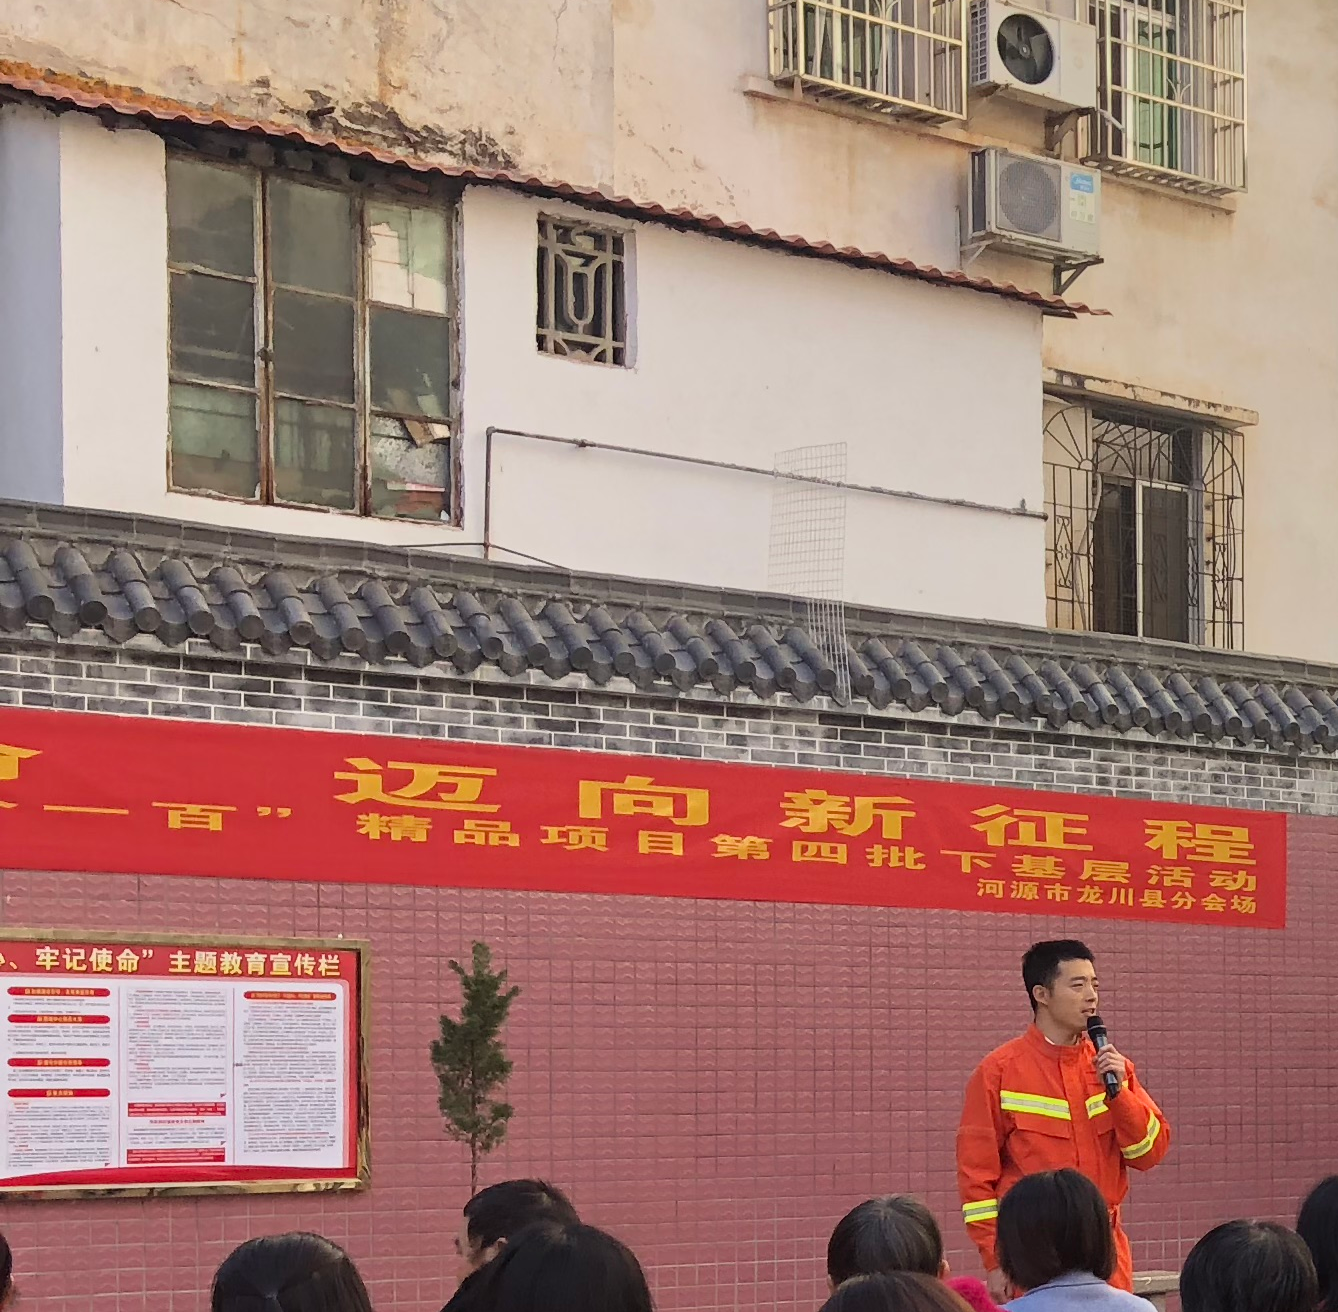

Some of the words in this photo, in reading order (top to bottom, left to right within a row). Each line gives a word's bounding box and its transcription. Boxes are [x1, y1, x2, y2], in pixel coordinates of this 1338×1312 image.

[333, 756, 1257, 867] 迈向新征程
[976, 878, 1257, 914] 河源市龙川县分会场
